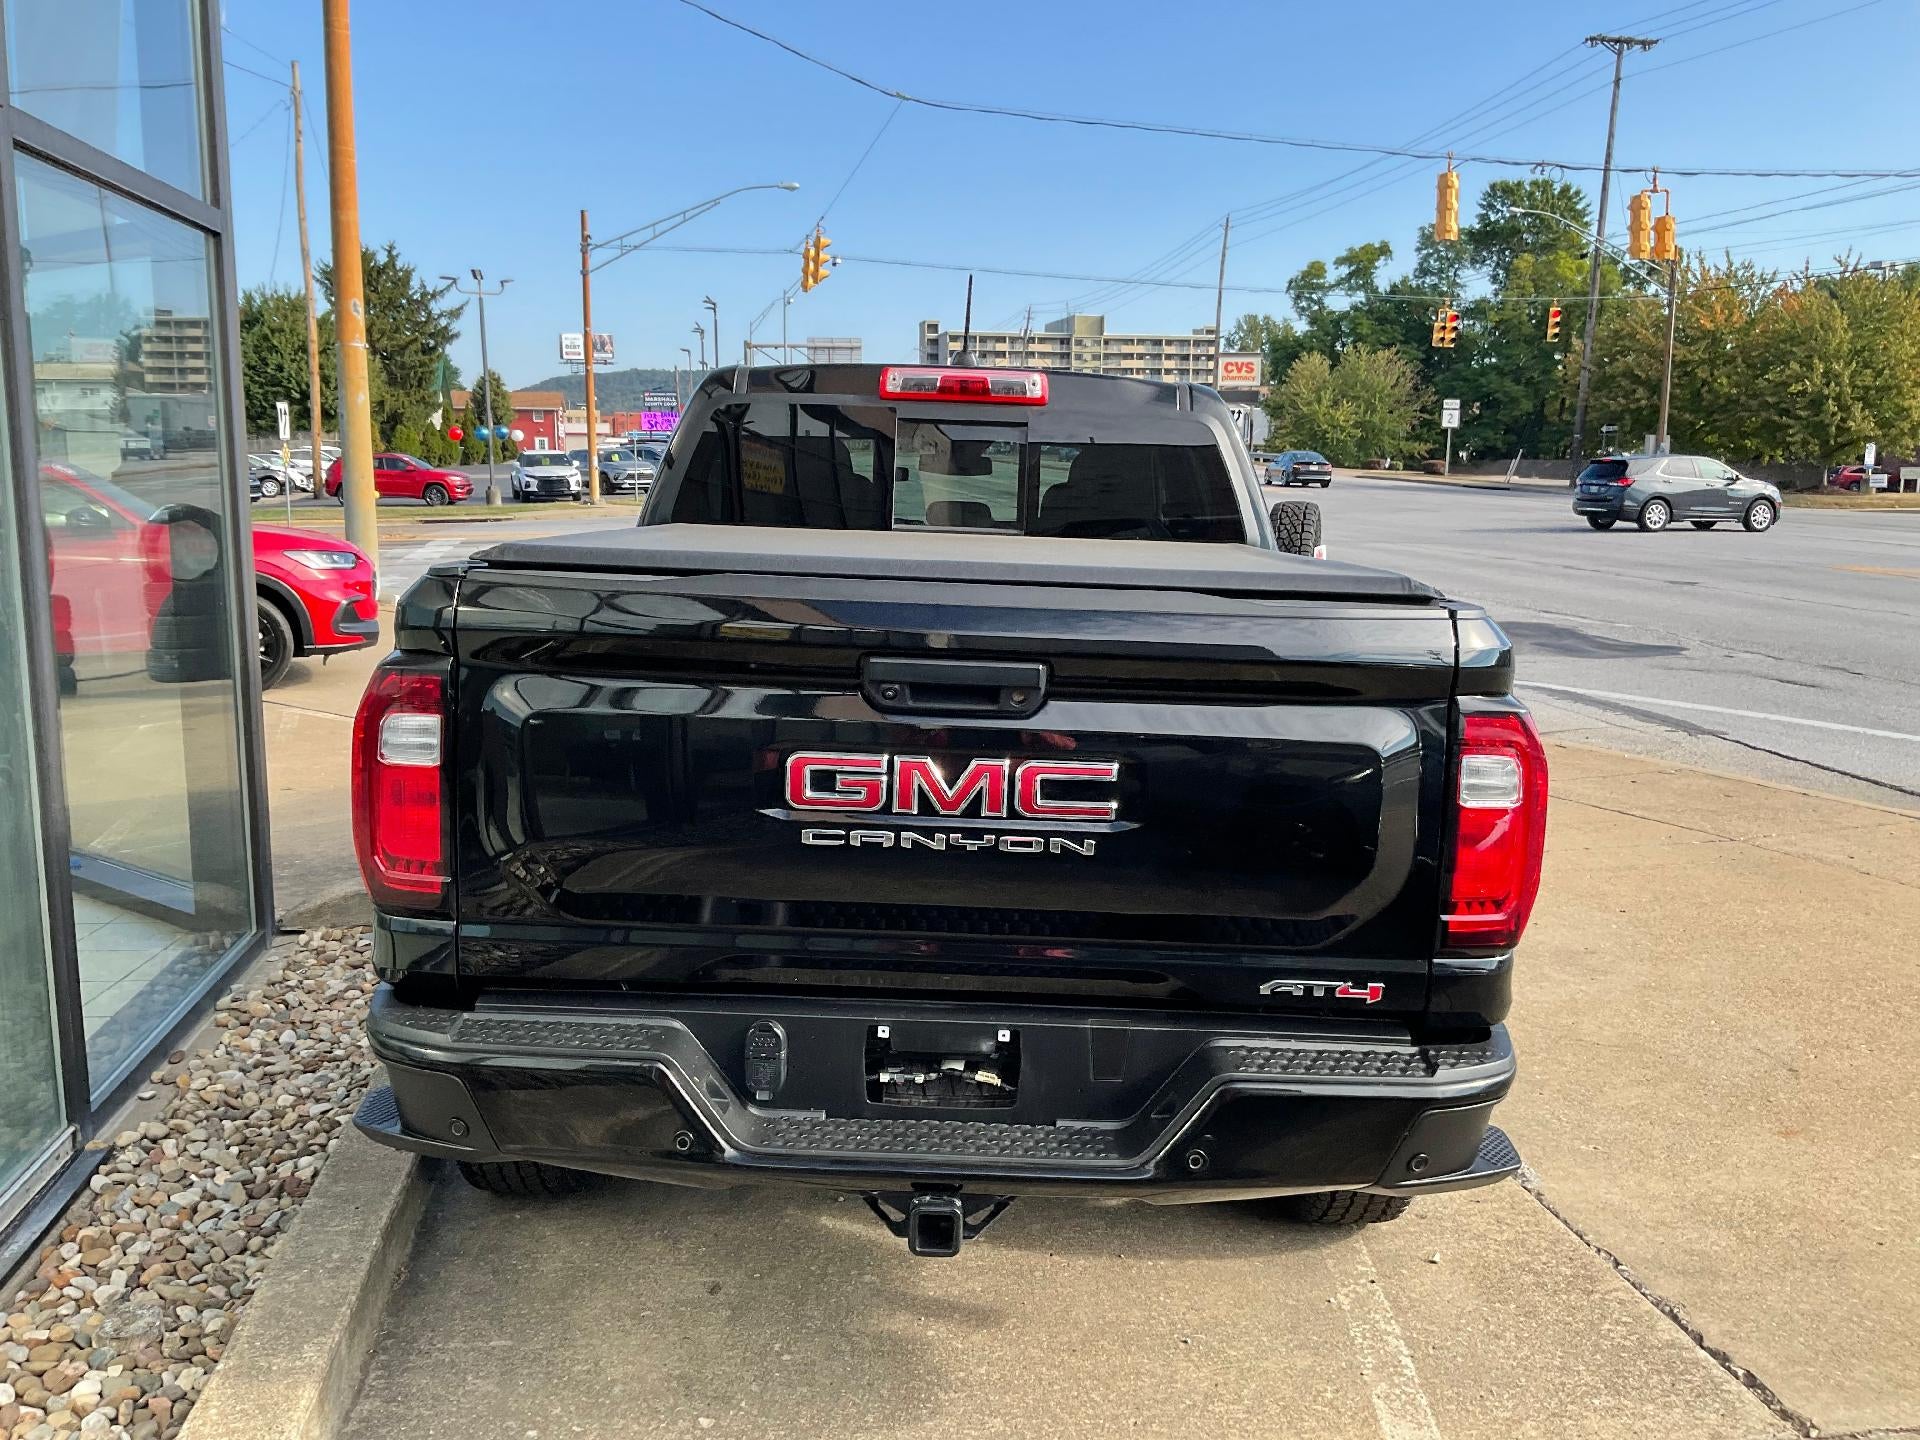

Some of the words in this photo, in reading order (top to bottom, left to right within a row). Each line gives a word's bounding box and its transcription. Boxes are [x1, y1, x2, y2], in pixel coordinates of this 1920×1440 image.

[1223, 361, 1255, 374] CVS
[1221, 374, 1256, 382] pharmacy
[1447, 413, 1453, 424] 2
[785, 751, 1120, 820] GMC
[801, 828, 1097, 856] CANYON
[1259, 979, 1386, 1004] AT4
